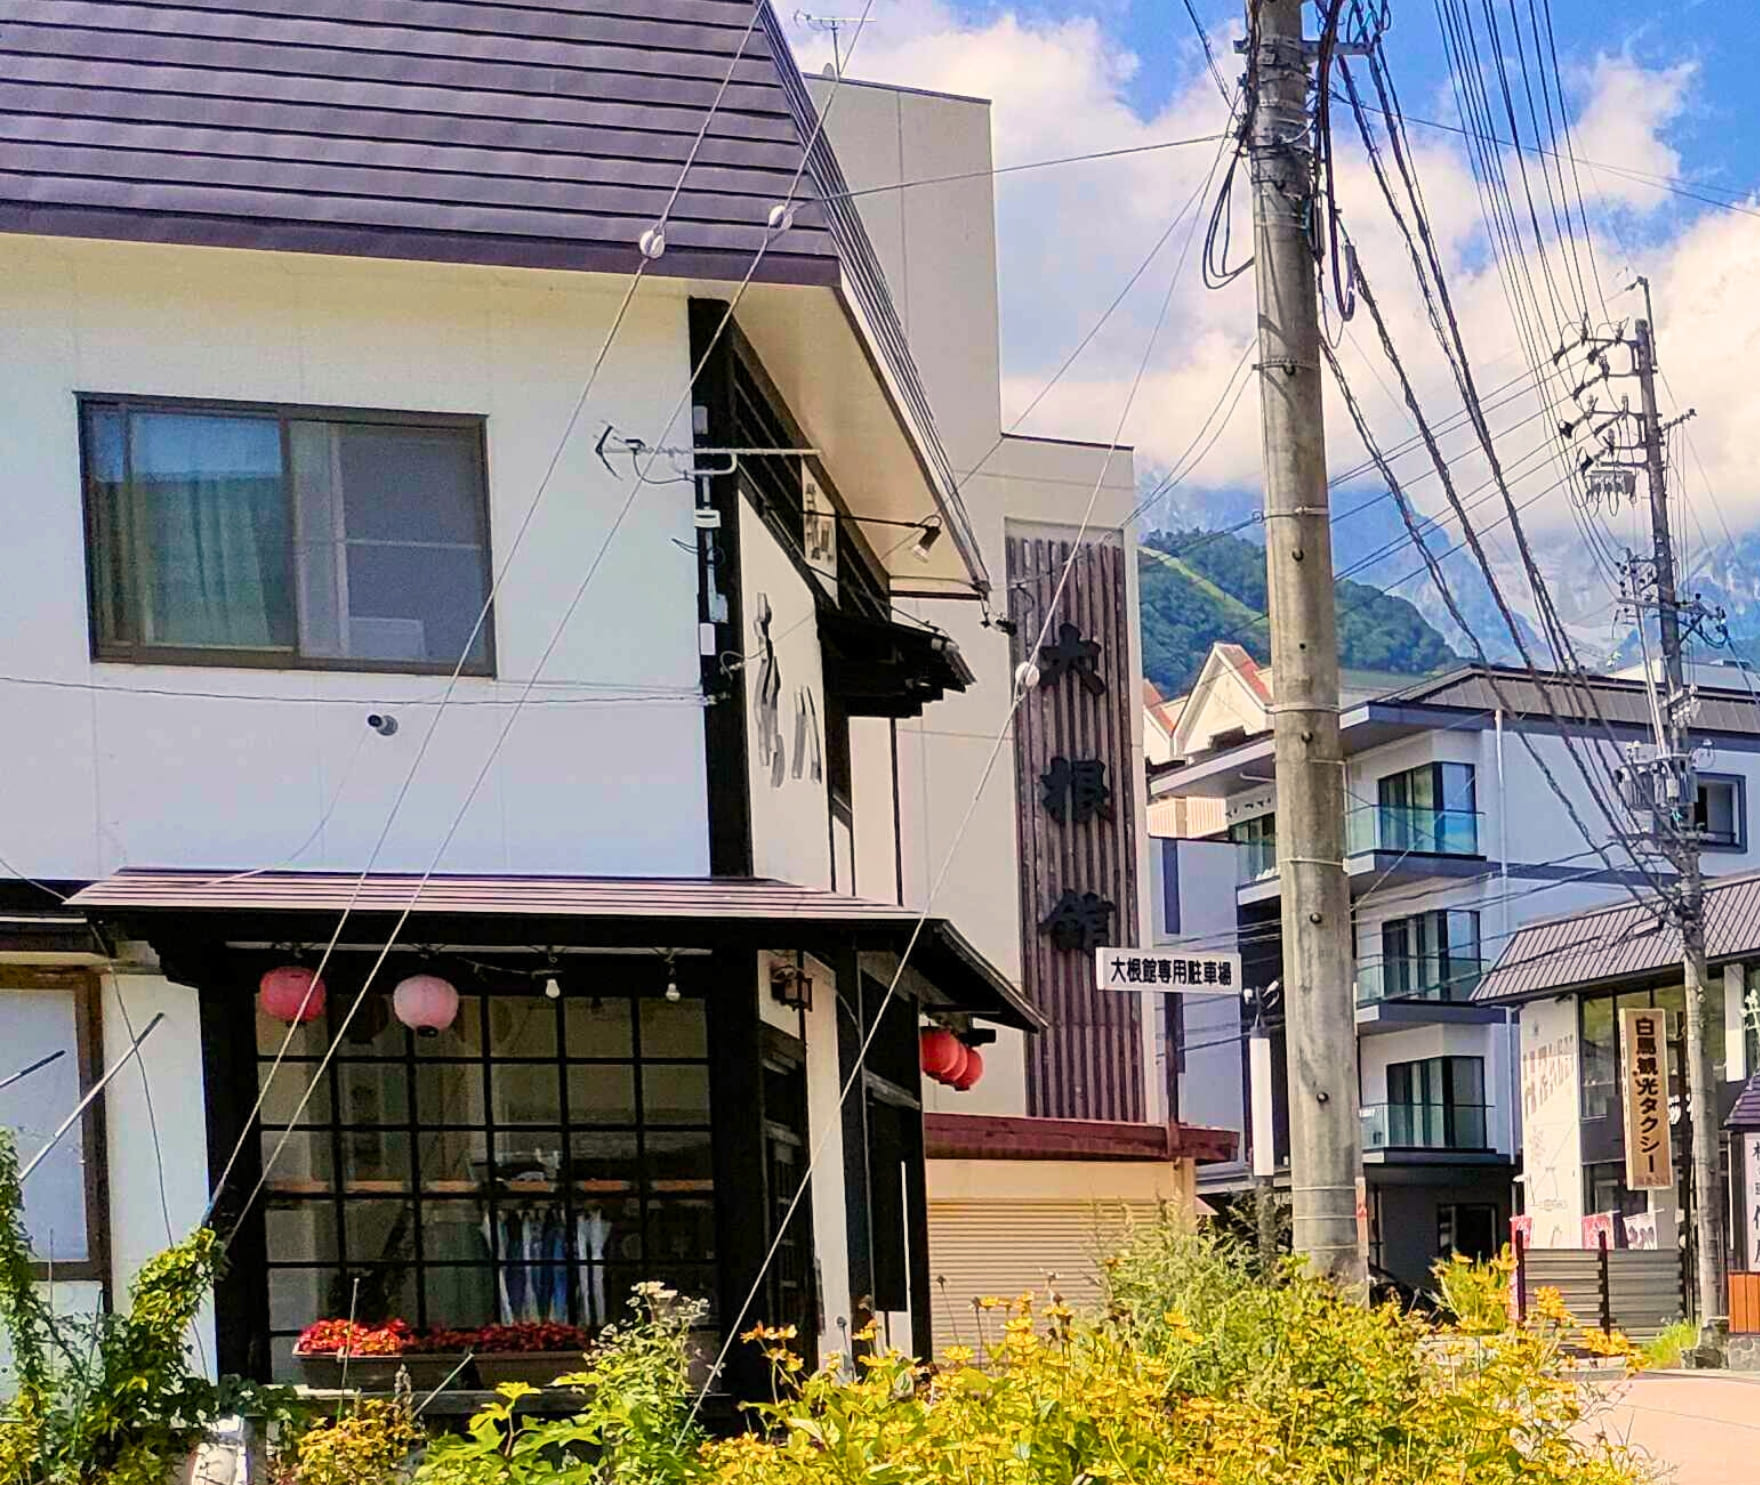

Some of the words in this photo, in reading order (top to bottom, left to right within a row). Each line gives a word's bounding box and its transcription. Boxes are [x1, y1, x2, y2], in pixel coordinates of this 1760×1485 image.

[1635, 1016, 1660, 1173] 白馬観光タクシー
